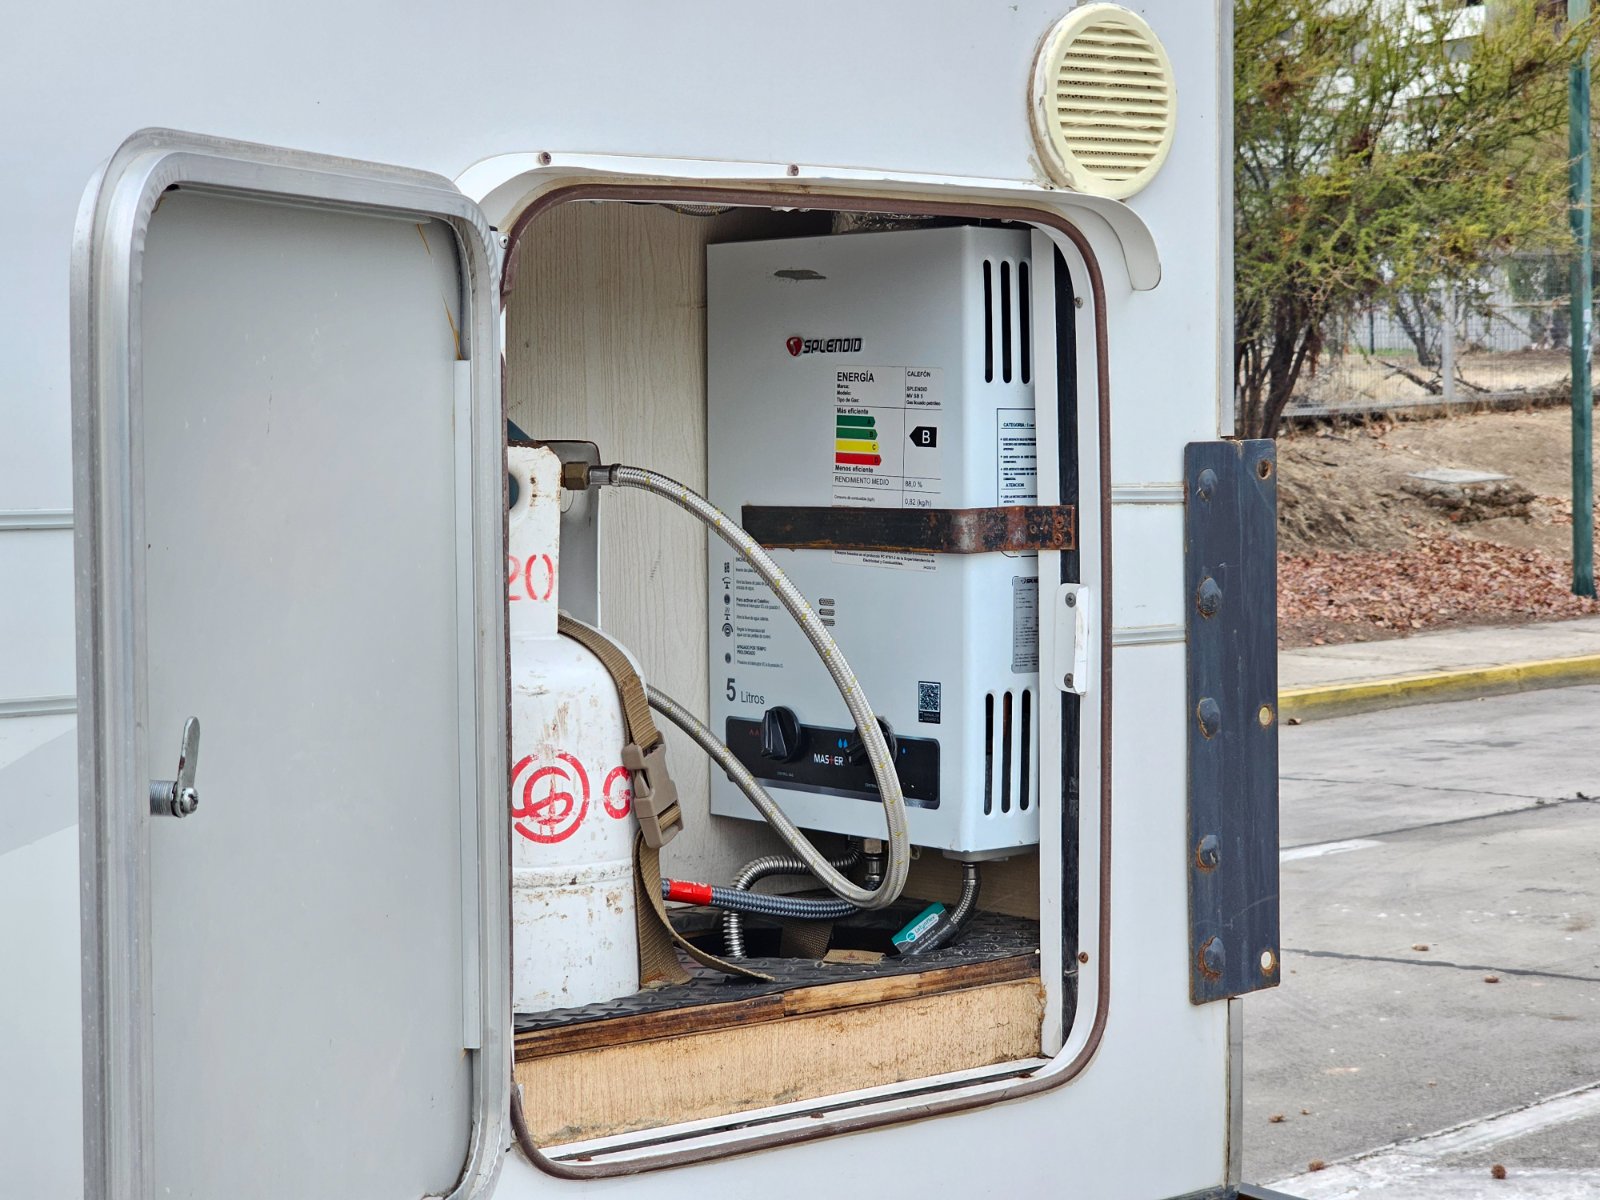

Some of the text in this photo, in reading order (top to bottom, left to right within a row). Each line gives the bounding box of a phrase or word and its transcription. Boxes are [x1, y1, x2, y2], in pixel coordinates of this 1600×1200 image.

[803, 338, 862, 354] SPLENDID
[837, 371, 875, 383] ENERGÍA
[907, 370, 931, 378] CALEFÓN
[922, 430, 931, 444] B
[835, 476, 871, 485] RENDIMIENTO
[905, 498, 916, 506] 0,82
[726, 678, 736, 702] 5
[740, 690, 765, 705] Litros
